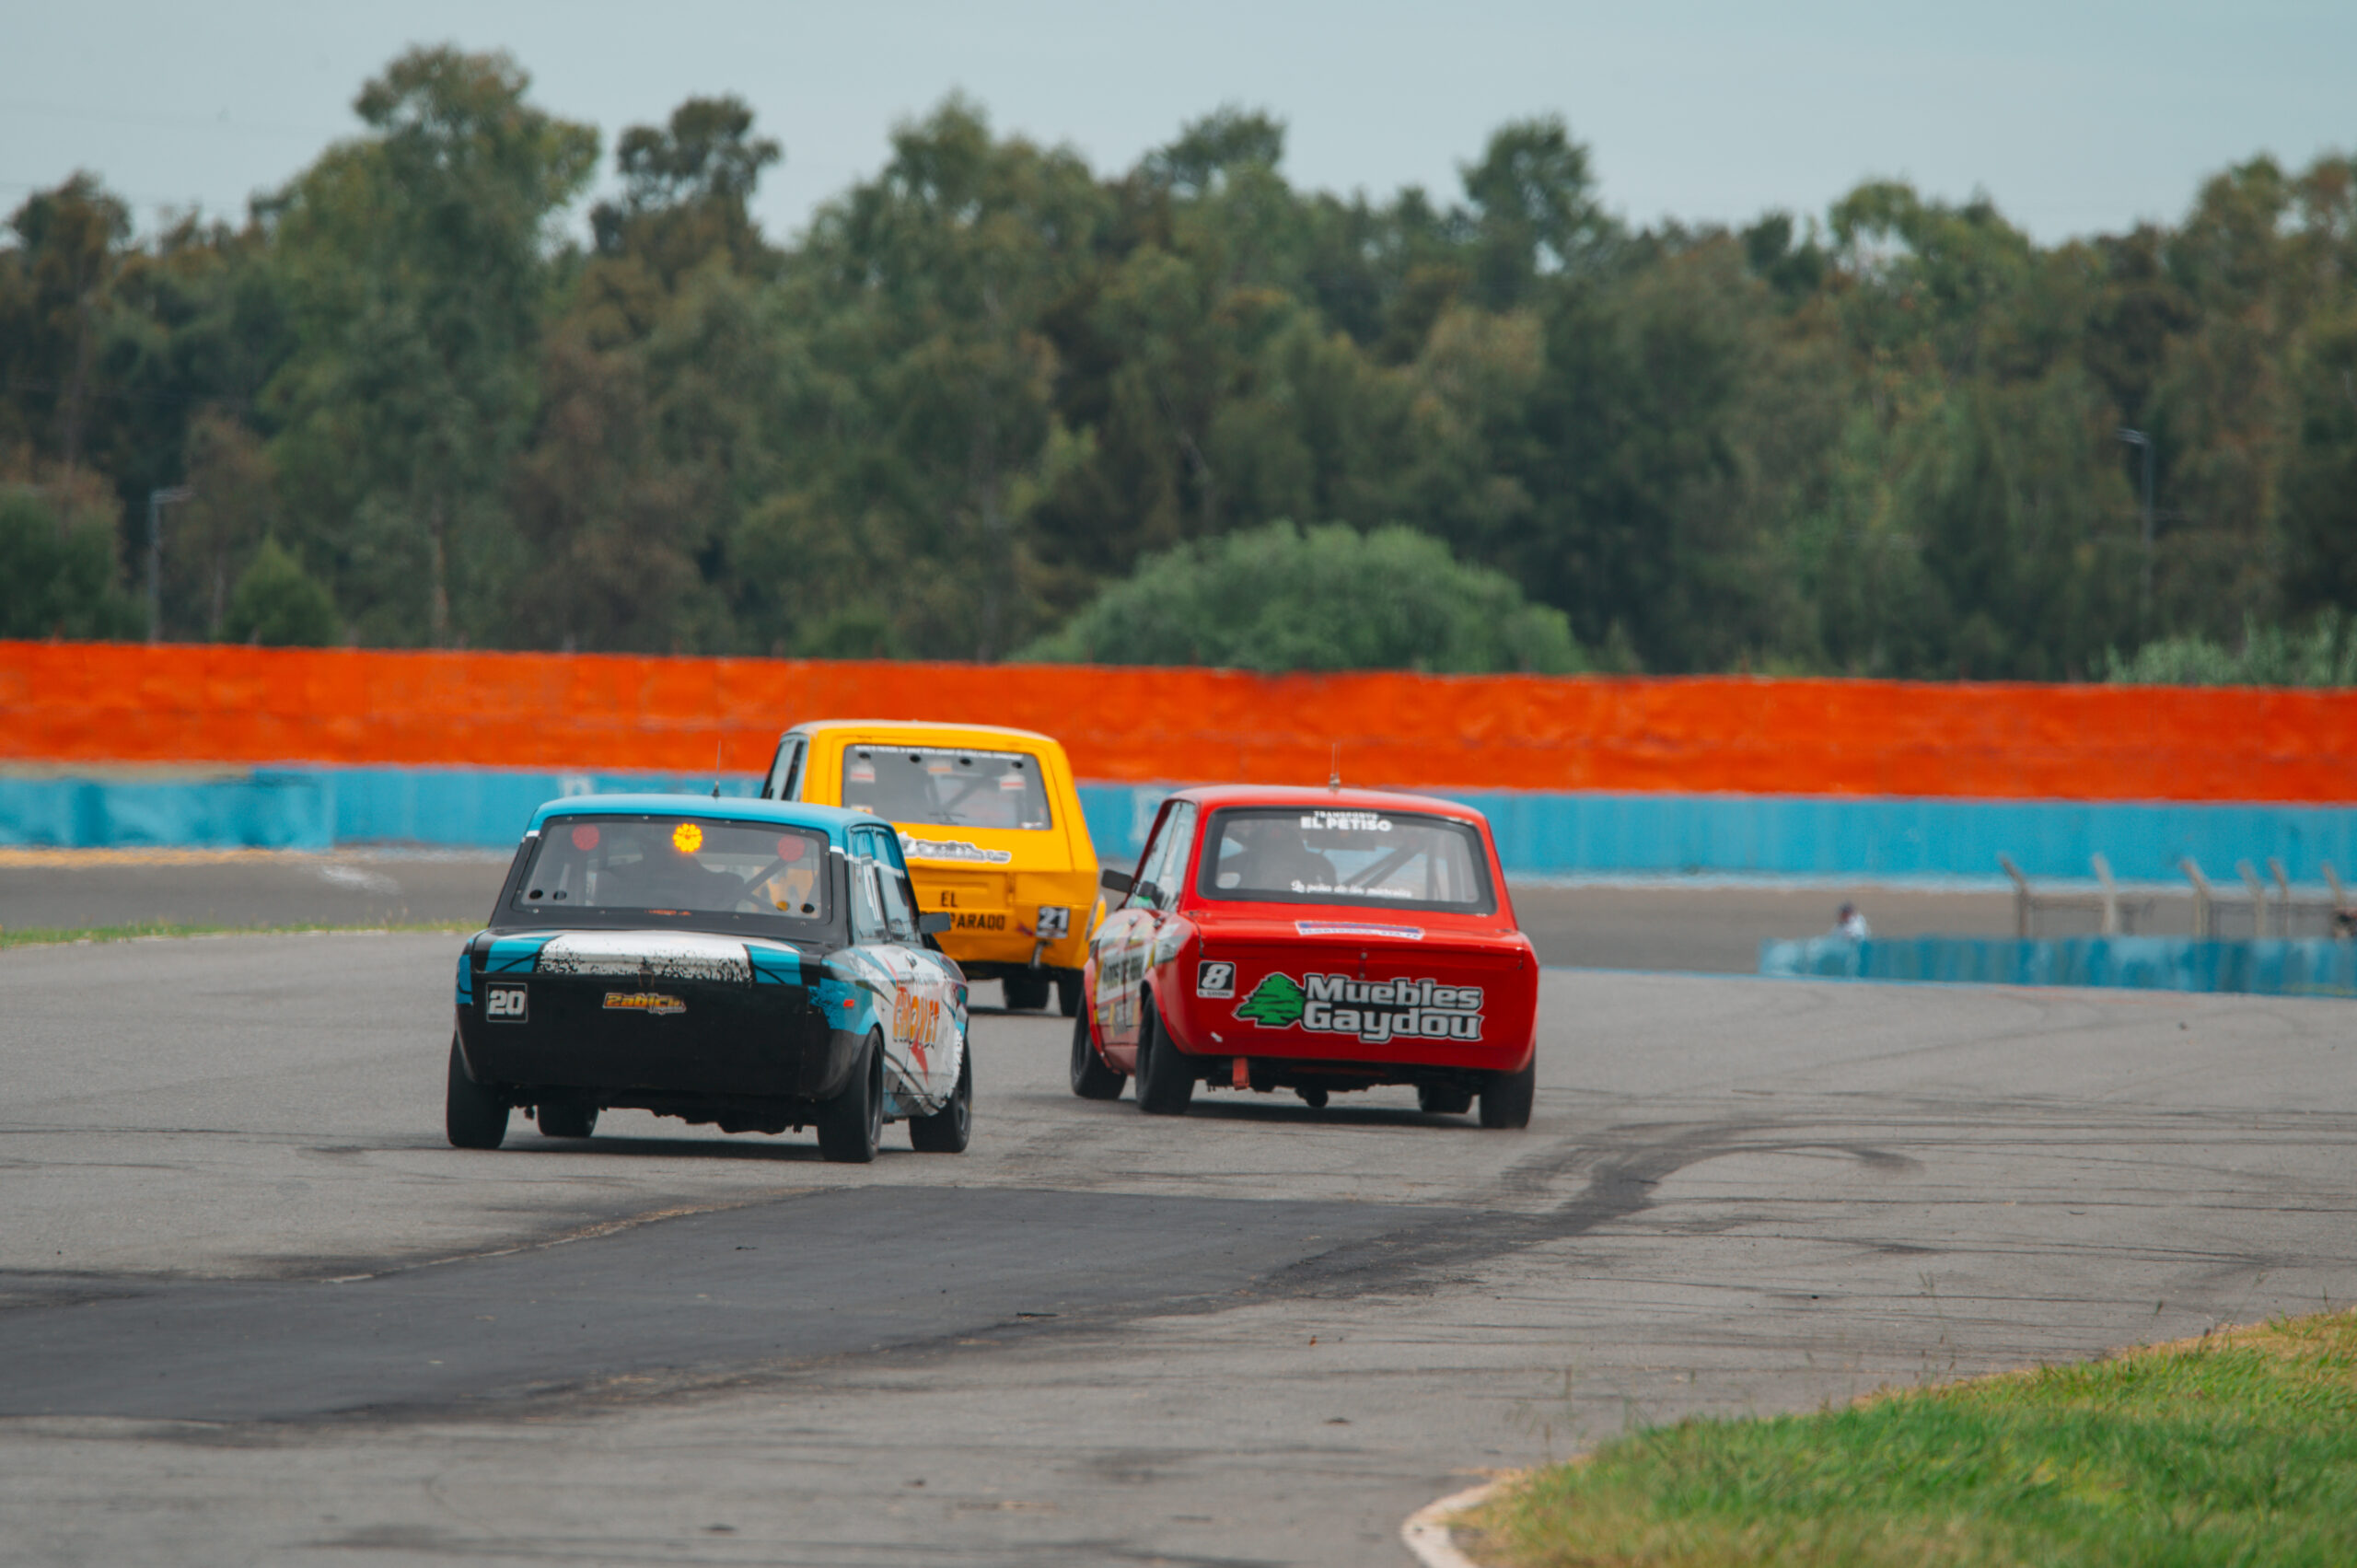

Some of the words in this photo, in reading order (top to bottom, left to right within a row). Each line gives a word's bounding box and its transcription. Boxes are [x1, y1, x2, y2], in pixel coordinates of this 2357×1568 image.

[1300, 816, 1323, 830] EL
[1326, 817, 1393, 831] PETISO
[940, 890, 958, 908] EL
[1038, 908, 1069, 929] 21
[1201, 963, 1232, 990] 8
[489, 989, 526, 1016] 20
[1306, 975, 1481, 1009] Muebles
[1303, 1000, 1480, 1041] Gaydou
